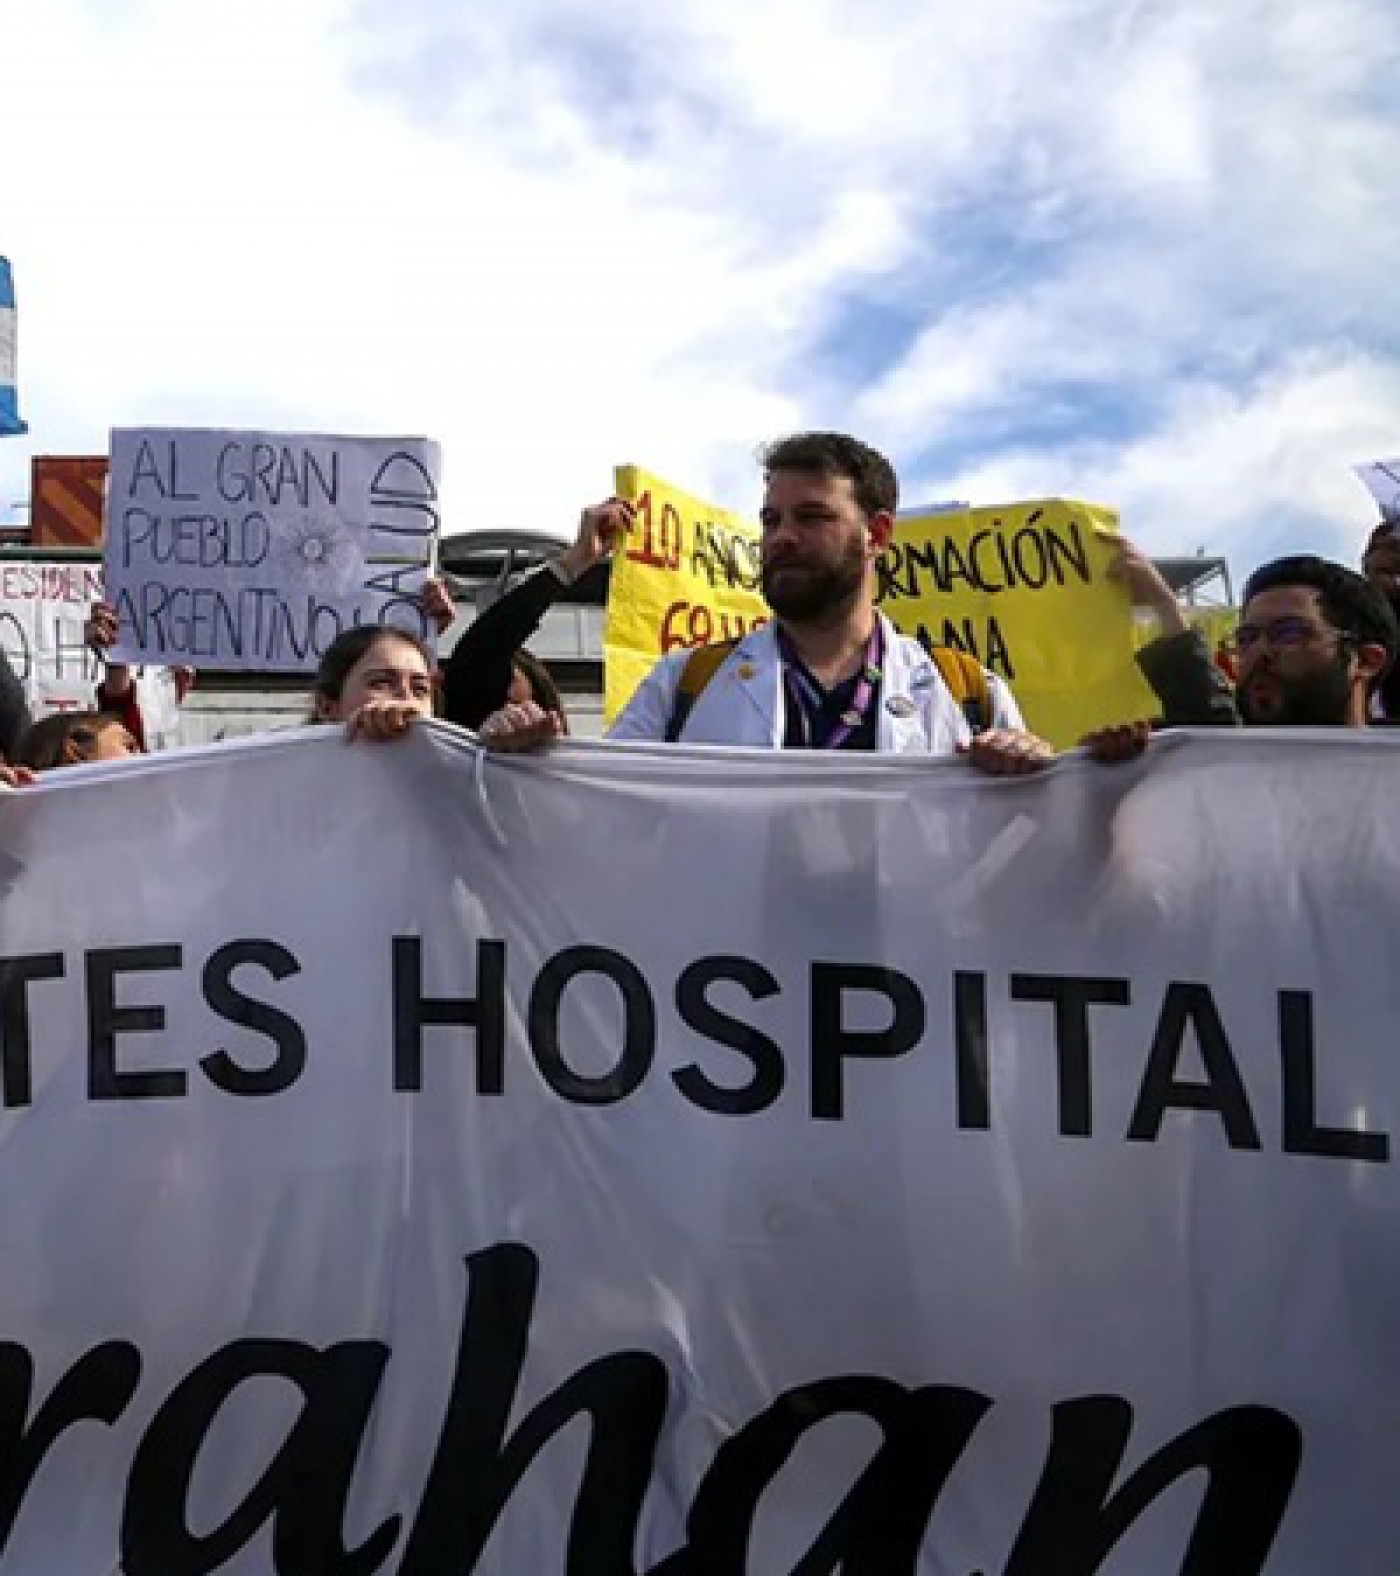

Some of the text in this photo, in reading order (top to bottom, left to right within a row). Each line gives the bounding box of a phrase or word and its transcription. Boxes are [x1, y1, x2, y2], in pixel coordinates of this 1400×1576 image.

[129, 440, 338, 508] AL GRAN
[121, 507, 271, 567] PUEBLO
[626, 490, 682, 571] 10
[116, 580, 344, 661] ARGENTINO
[391, 934, 1390, 1163] HOSPITAL
